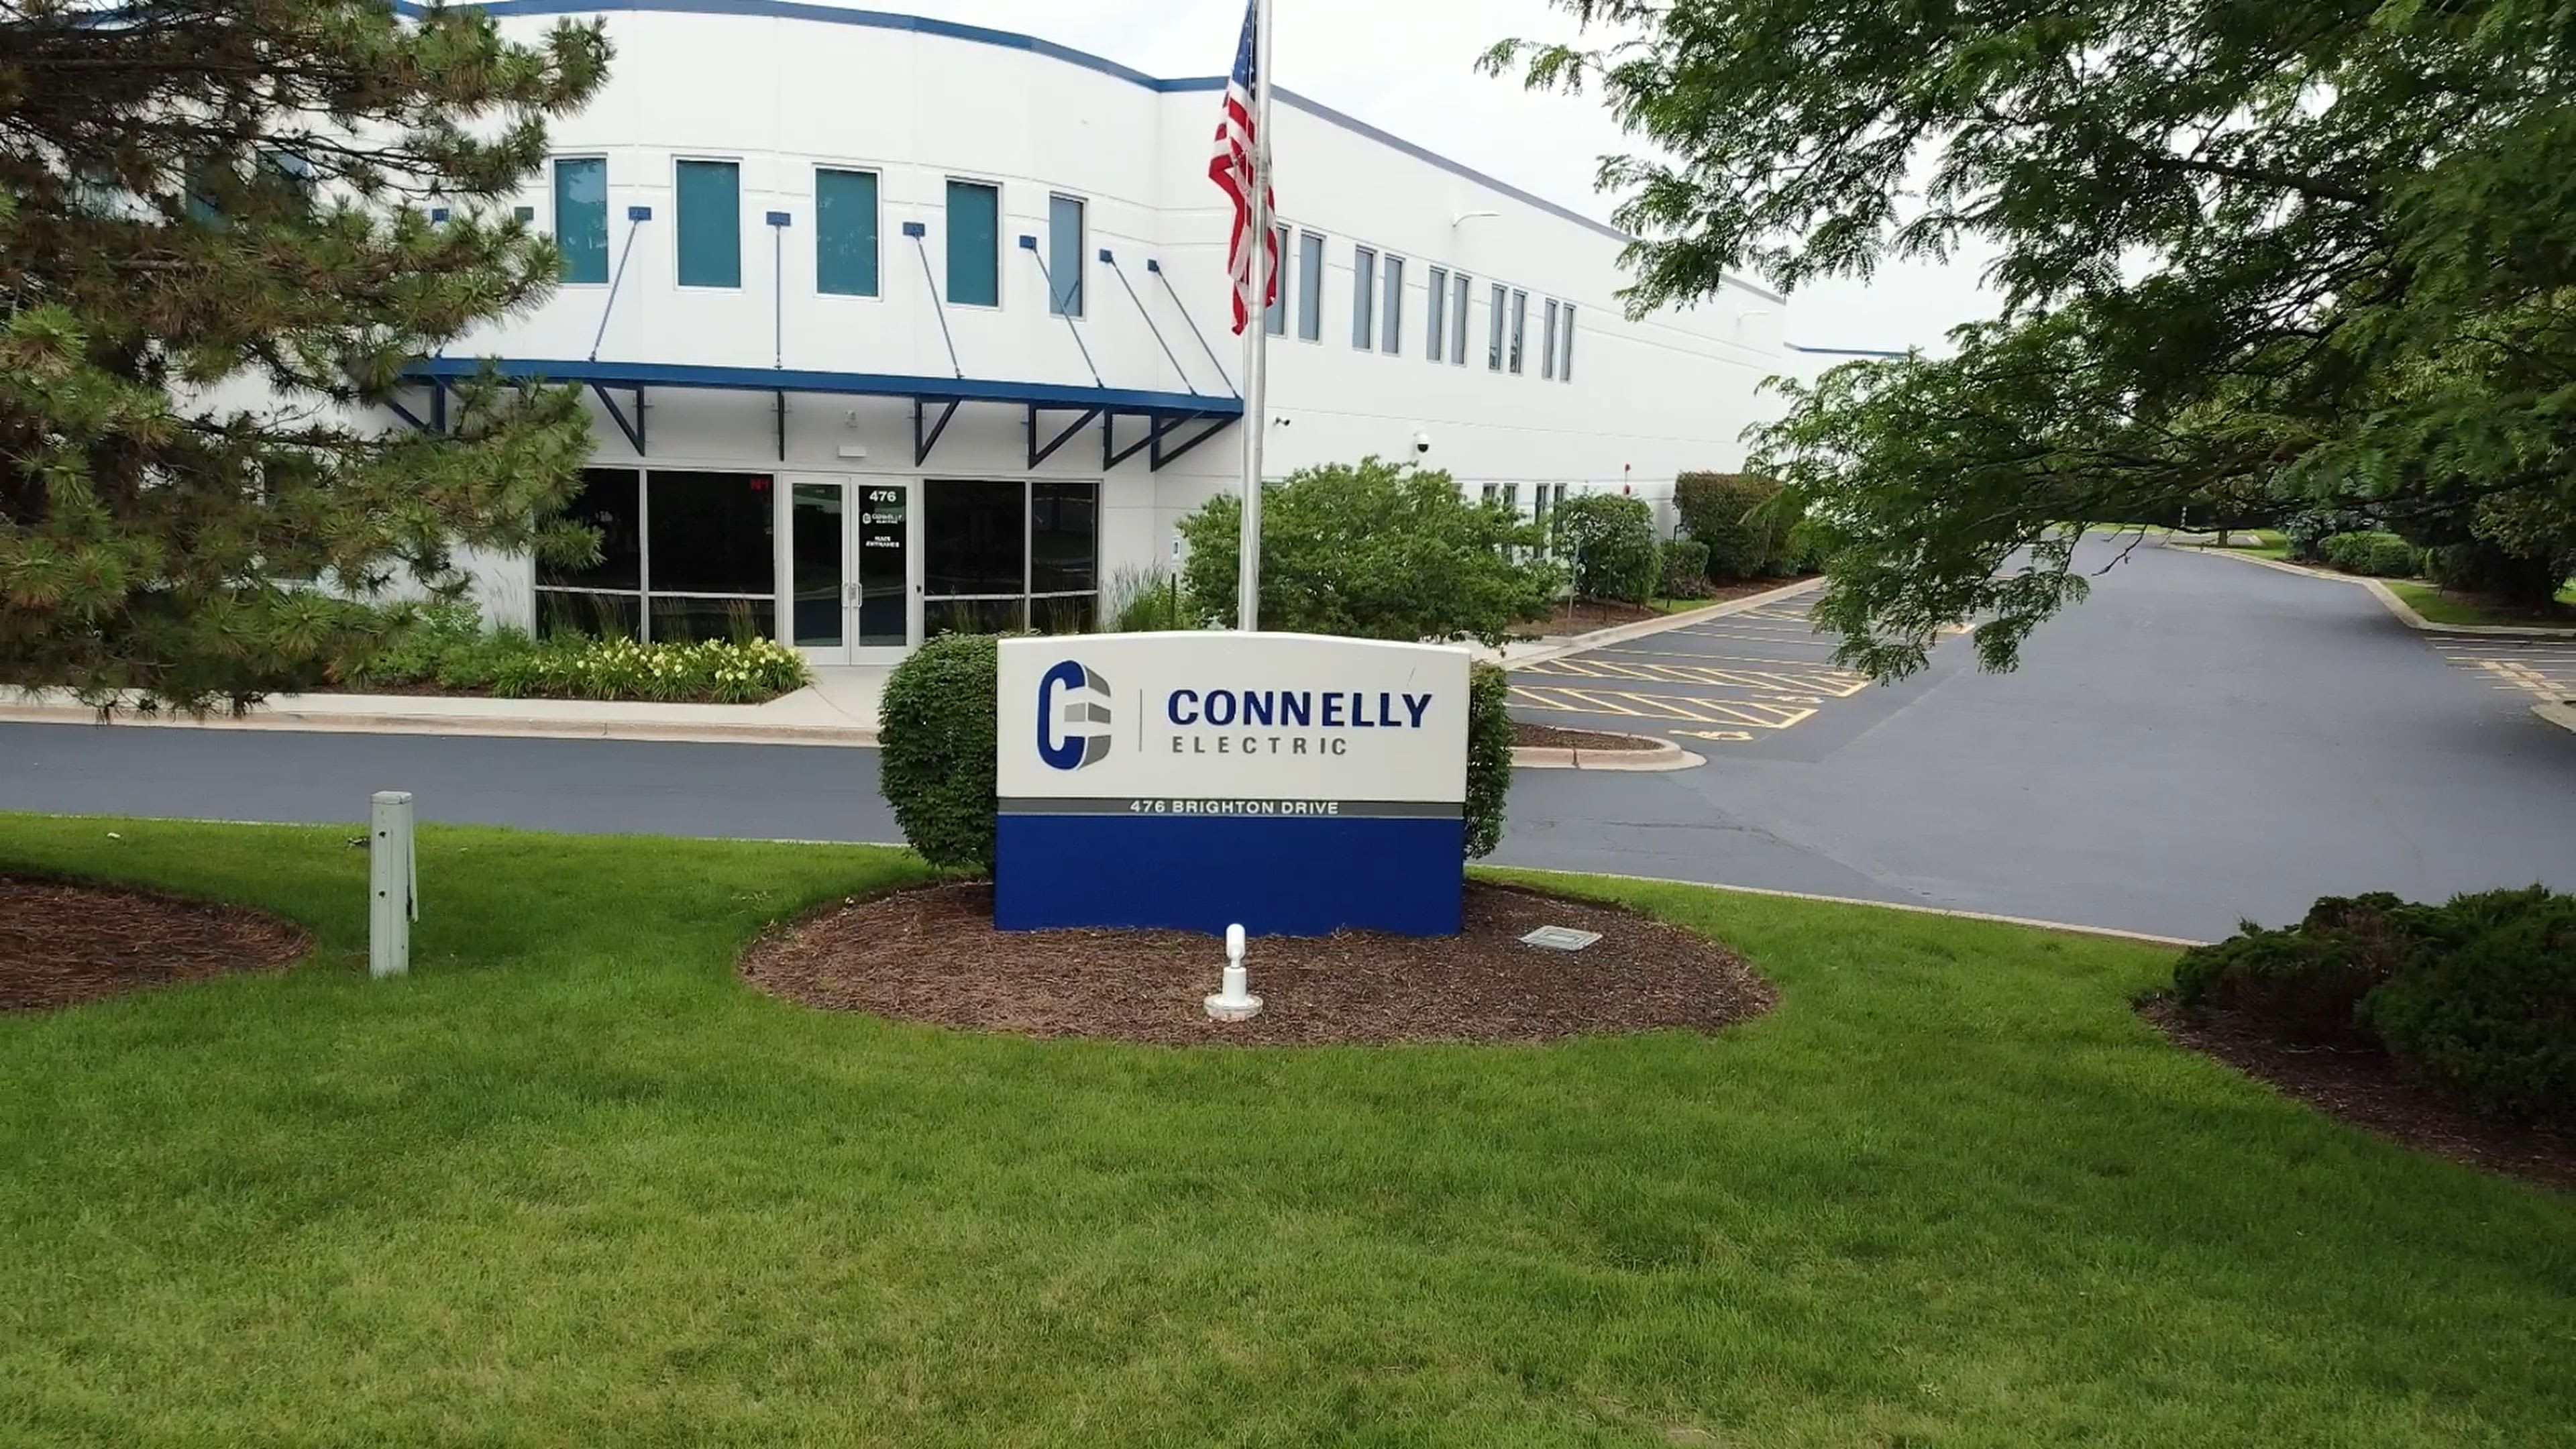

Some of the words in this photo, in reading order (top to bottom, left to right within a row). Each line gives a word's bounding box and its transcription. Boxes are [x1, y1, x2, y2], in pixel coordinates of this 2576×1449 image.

[869, 490, 896, 502] 476
[1168, 689, 1432, 728] CONNELLY
[1172, 736, 1346, 755] ELECTRIC
[1130, 800, 1165, 813] 476
[1173, 801, 1274, 814] BRIGHTON
[1281, 802, 1338, 814] DRIVE
